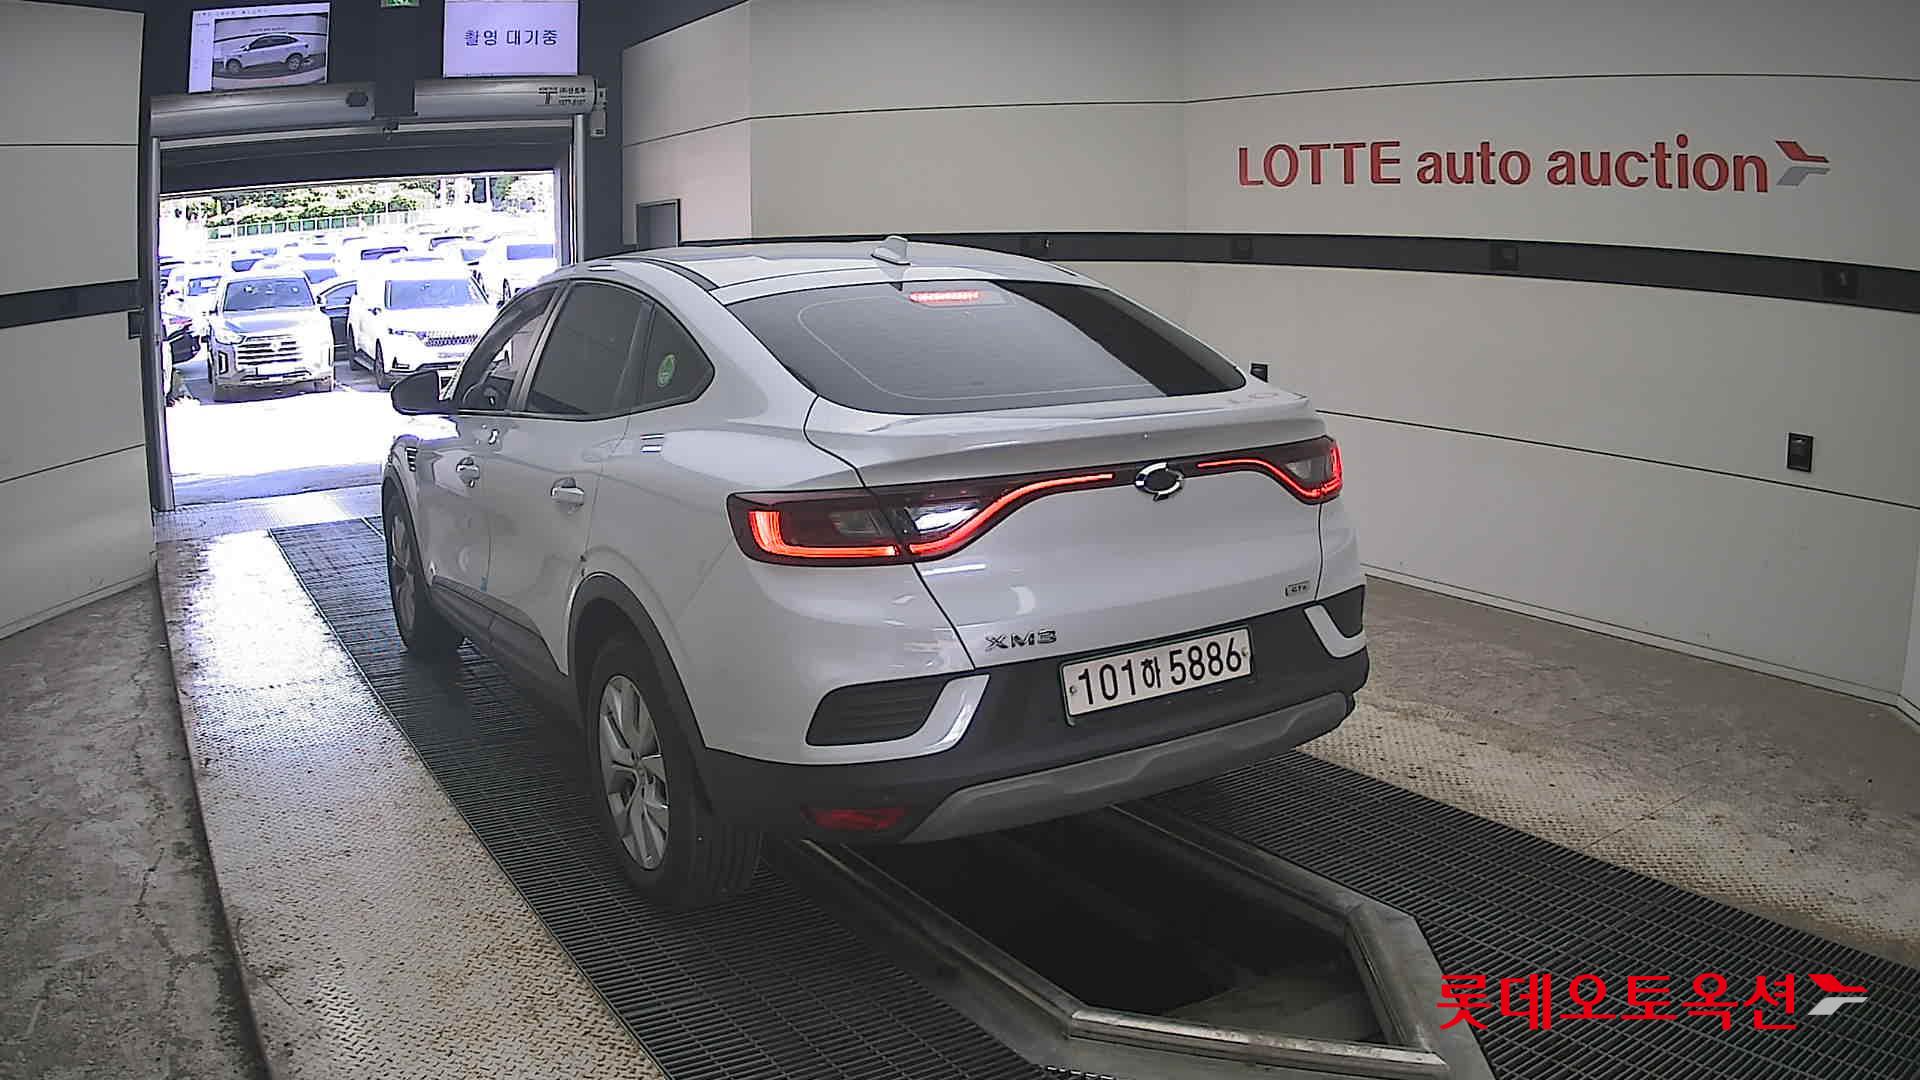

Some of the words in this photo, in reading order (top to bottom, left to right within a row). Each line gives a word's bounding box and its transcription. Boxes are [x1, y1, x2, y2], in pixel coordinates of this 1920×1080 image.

[506, 29, 558, 46] 대기중
[1239, 142, 1400, 187] LOTTE
[1416, 142, 1532, 186] auto
[1546, 134, 1769, 193] auction
[985, 630, 1057, 650] XM3
[1169, 637, 1242, 686] 5886
